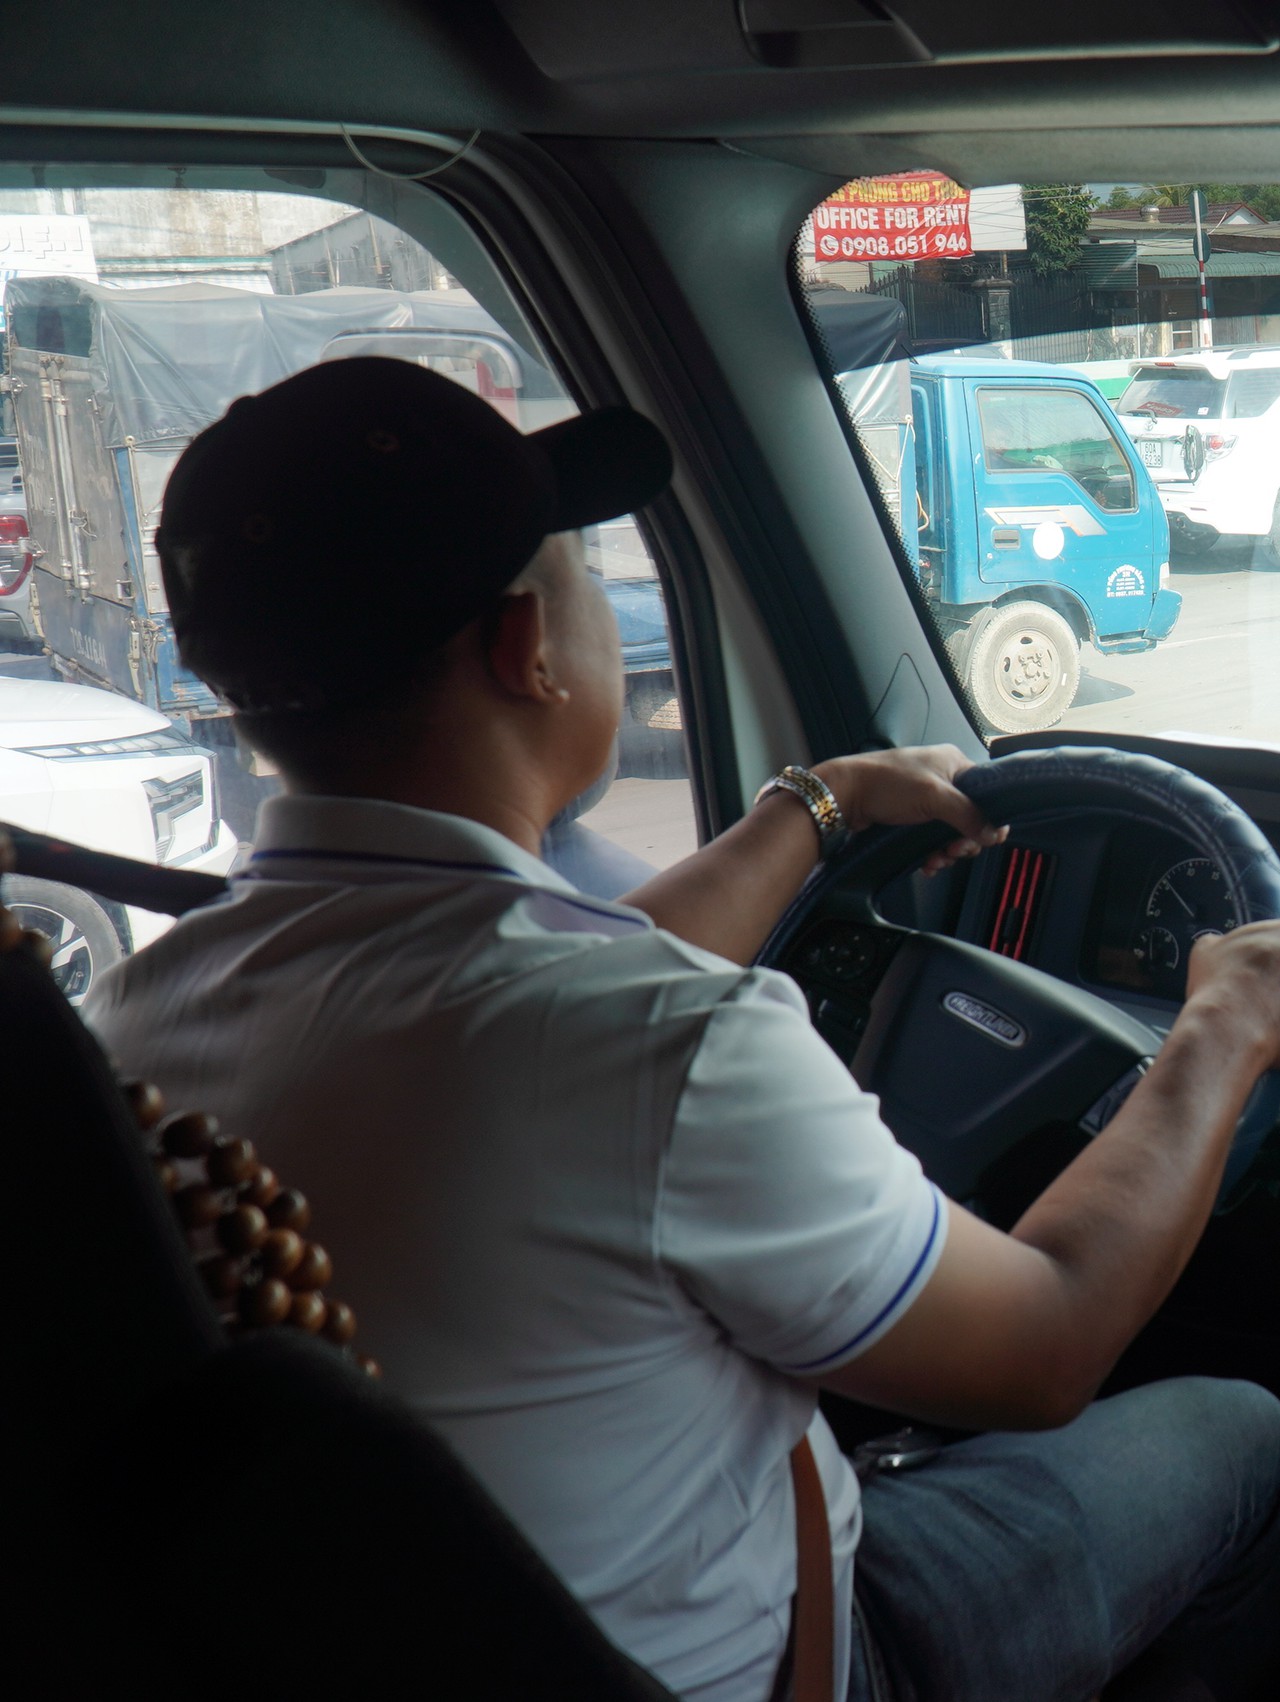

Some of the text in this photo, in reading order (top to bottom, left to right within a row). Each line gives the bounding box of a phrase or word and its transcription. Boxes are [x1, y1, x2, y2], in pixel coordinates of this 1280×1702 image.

[901, 182, 930, 203] CHO
[816, 204, 968, 230] OFFICE FOR RENT
[841, 232, 968, 257] 0908.051 946
[950, 997, 1018, 1038] FREIGHTLINER
